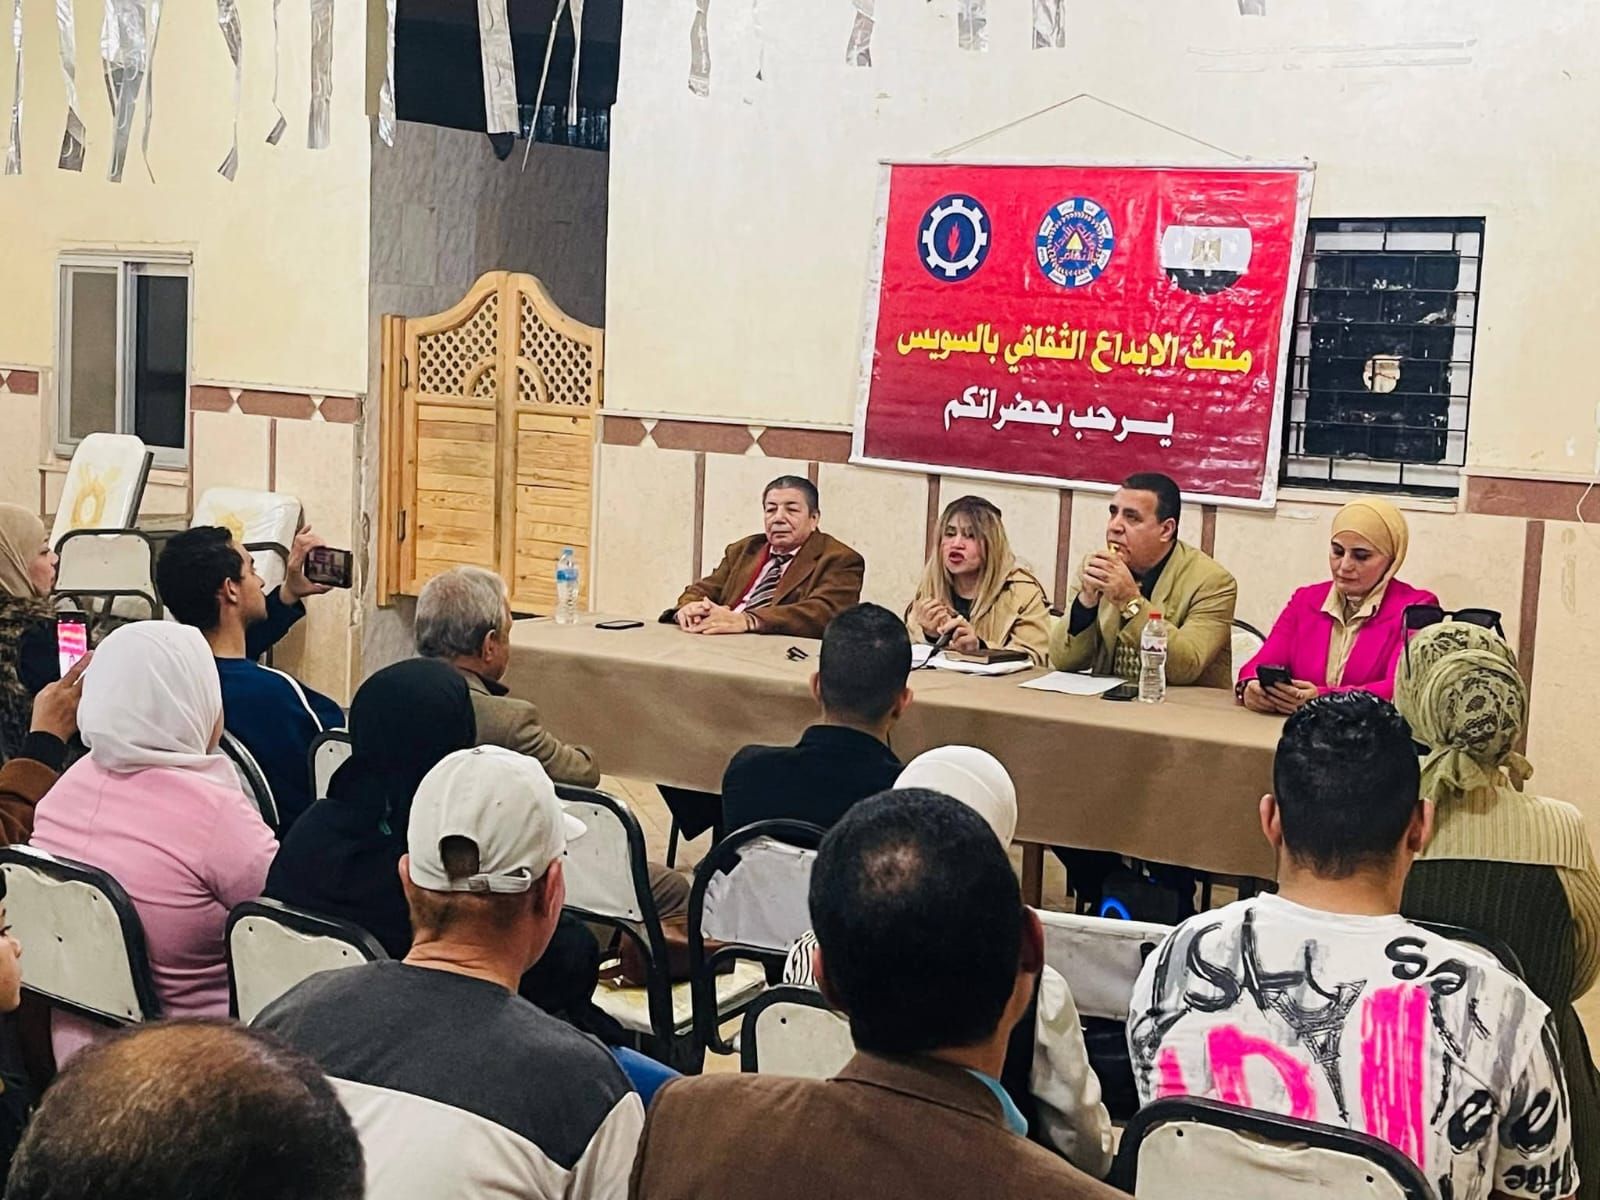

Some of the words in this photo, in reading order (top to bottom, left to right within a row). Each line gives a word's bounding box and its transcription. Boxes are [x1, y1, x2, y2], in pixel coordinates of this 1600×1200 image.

[897, 322, 999, 365] بالسويس
[1004, 321, 1088, 374] الثقافي
[1184, 331, 1253, 375] مثلث
[943, 385, 1063, 436] بحضراتكم
